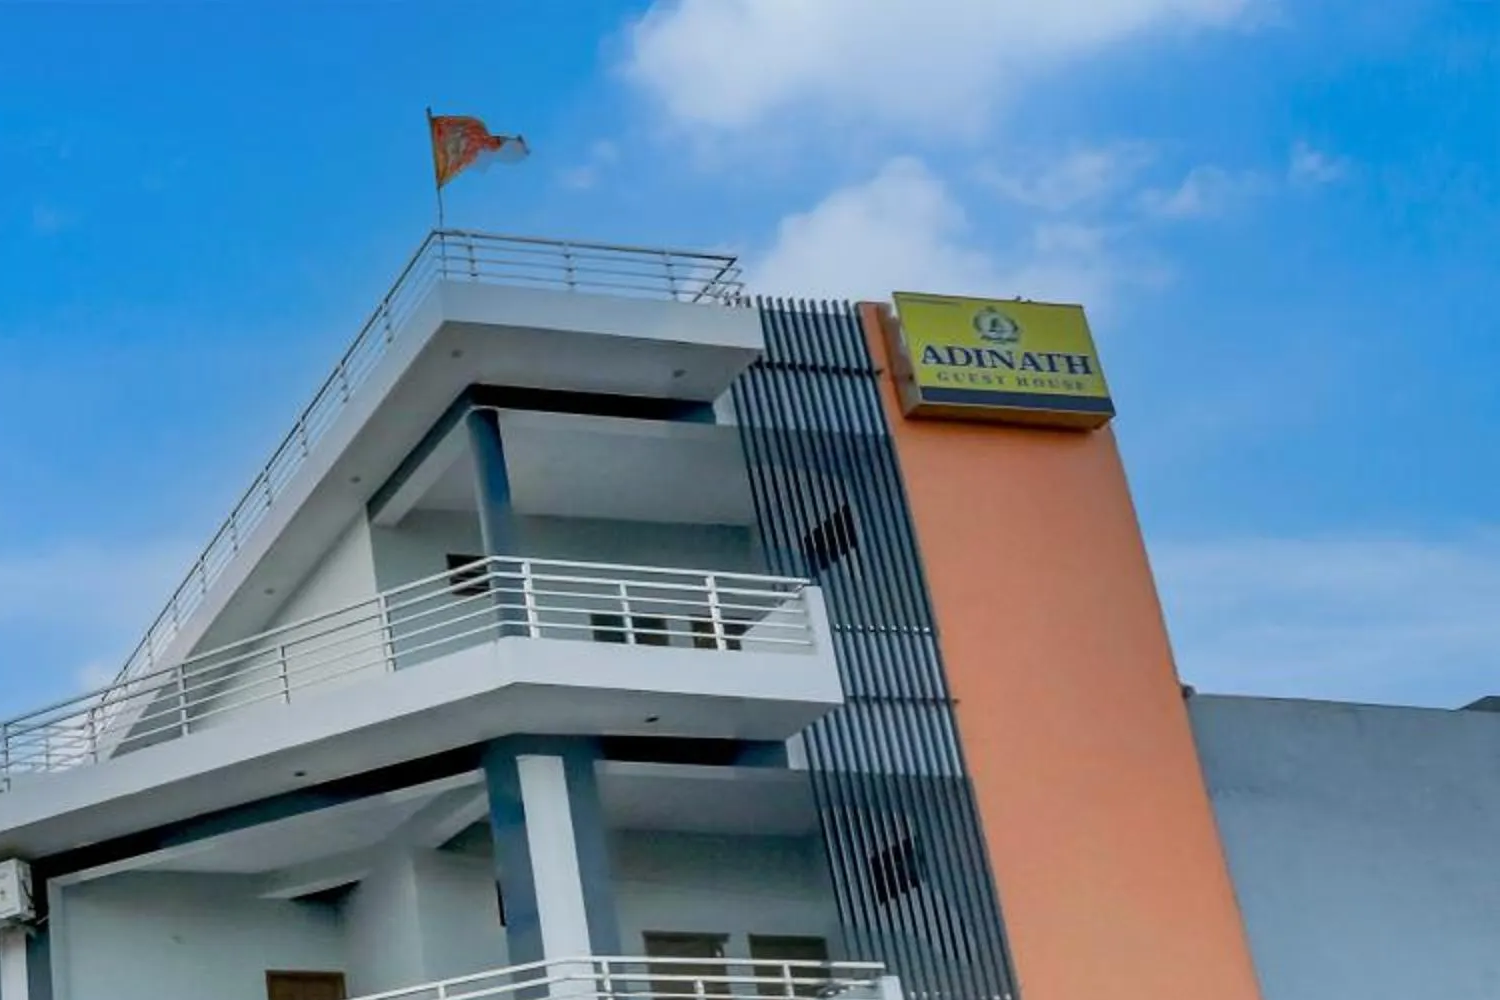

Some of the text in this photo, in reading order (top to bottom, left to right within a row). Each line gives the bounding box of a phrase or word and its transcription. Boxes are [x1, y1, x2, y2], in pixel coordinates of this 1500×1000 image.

[921, 344, 1093, 375] ADINATH
[937, 371, 1085, 391] GUEST HOUSE
